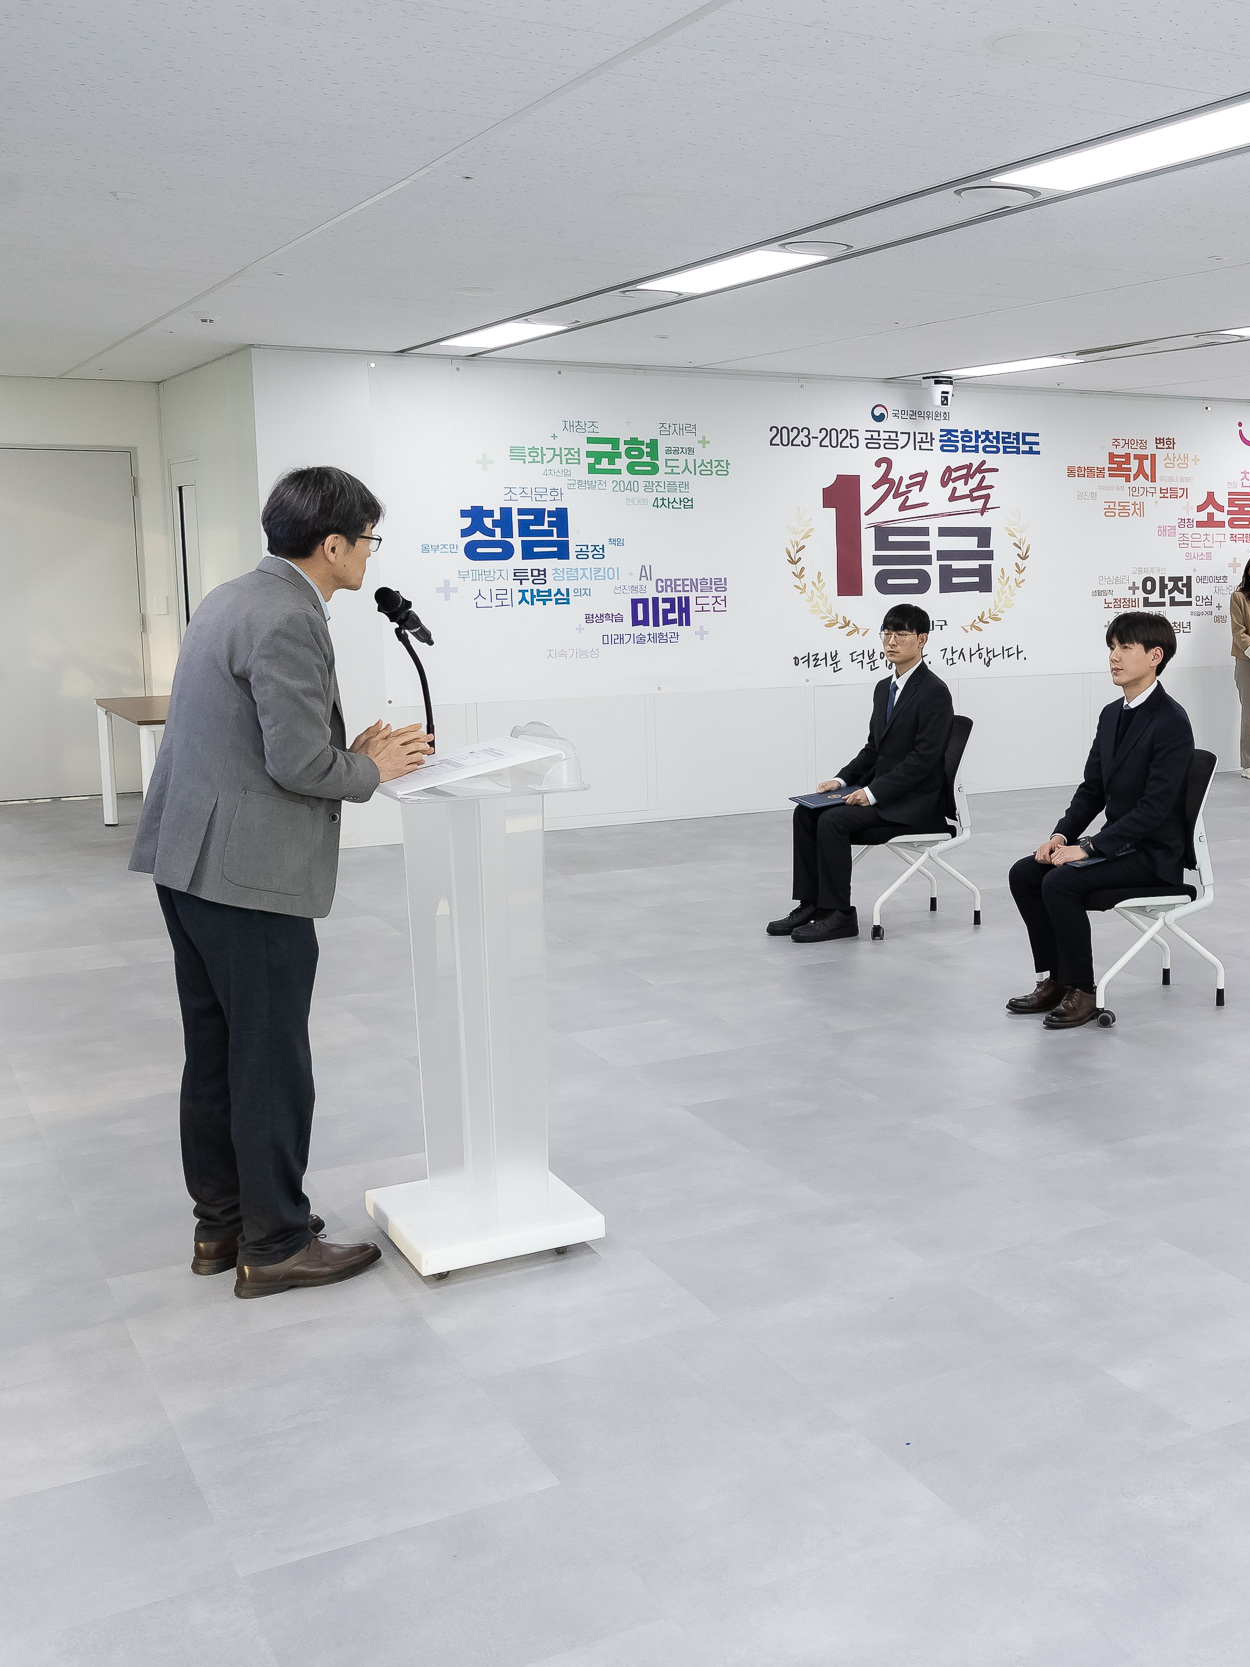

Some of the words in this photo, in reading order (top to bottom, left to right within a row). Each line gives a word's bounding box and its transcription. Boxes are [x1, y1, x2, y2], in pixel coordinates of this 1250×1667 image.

[891, 409, 950, 421] 국민권익위원회
[562, 420, 600, 433] 재창조
[658, 422, 697, 436] 잠재력
[769, 426, 859, 449] 2023-2025
[864, 429, 935, 451] 공공기관
[939, 428, 1041, 455] 종합청렴도
[1111, 438, 1148, 450] 주거안정
[1155, 437, 1176, 450] 변화
[509, 446, 581, 465] 특화거점
[586, 436, 660, 475] 균형
[664, 447, 695, 455] 공공지원
[1163, 453, 1189, 468] 상생
[543, 469, 572, 477] 4차산업
[664, 459, 731, 476] 도시성장
[1066, 466, 1105, 478] 통합돌봄
[1107, 452, 1157, 483] 복지
[566, 479, 607, 490] 균형발전
[612, 480, 639, 492] 2040
[643, 480, 690, 493] 광진플랜
[864, 457, 930, 516] 3년
[940, 459, 1000, 516] 연속
[503, 486, 564, 502] 조직문화
[1128, 486, 1157, 497] 1인가구
[1159, 487, 1189, 499] 보듬기
[652, 497, 694, 509] 4차산업
[1103, 500, 1145, 518] 공동체
[1178, 518, 1194, 529] 경청
[460, 505, 570, 561] 청렴
[1157, 525, 1176, 537] 해결
[608, 538, 625, 546] 책임
[1178, 533, 1226, 548] 좋은친구
[421, 544, 458, 554] 옴부즈만
[574, 544, 605, 560] 공정
[1185, 552, 1212, 561] 의사소통
[458, 569, 509, 582] 부패방지
[512, 568, 547, 585] 투명
[551, 567, 620, 581] 청렴지킴이
[639, 565, 652, 581] AI
[1196, 575, 1228, 584] 어린이보호
[655, 577, 728, 593] GREEN힐링
[1099, 575, 1130, 585] 안심쉼터
[573, 588, 591, 597] 의지
[613, 585, 647, 595] 선진행정
[1142, 576, 1192, 607] 안전
[473, 588, 513, 608] 신뢰
[518, 588, 570, 606] 자부심
[1104, 598, 1140, 609] 노점정비
[1195, 595, 1213, 607] 안심
[695, 595, 727, 613] 도전
[631, 596, 691, 627] 미래
[584, 613, 624, 624] 평생학습
[1213, 615, 1227, 623] 예방
[602, 632, 679, 645] 미래기술체험관
[546, 648, 600, 660] 지속가능성
[793, 650, 843, 673] 여러분
[940, 643, 1027, 667] 감사합니다.
